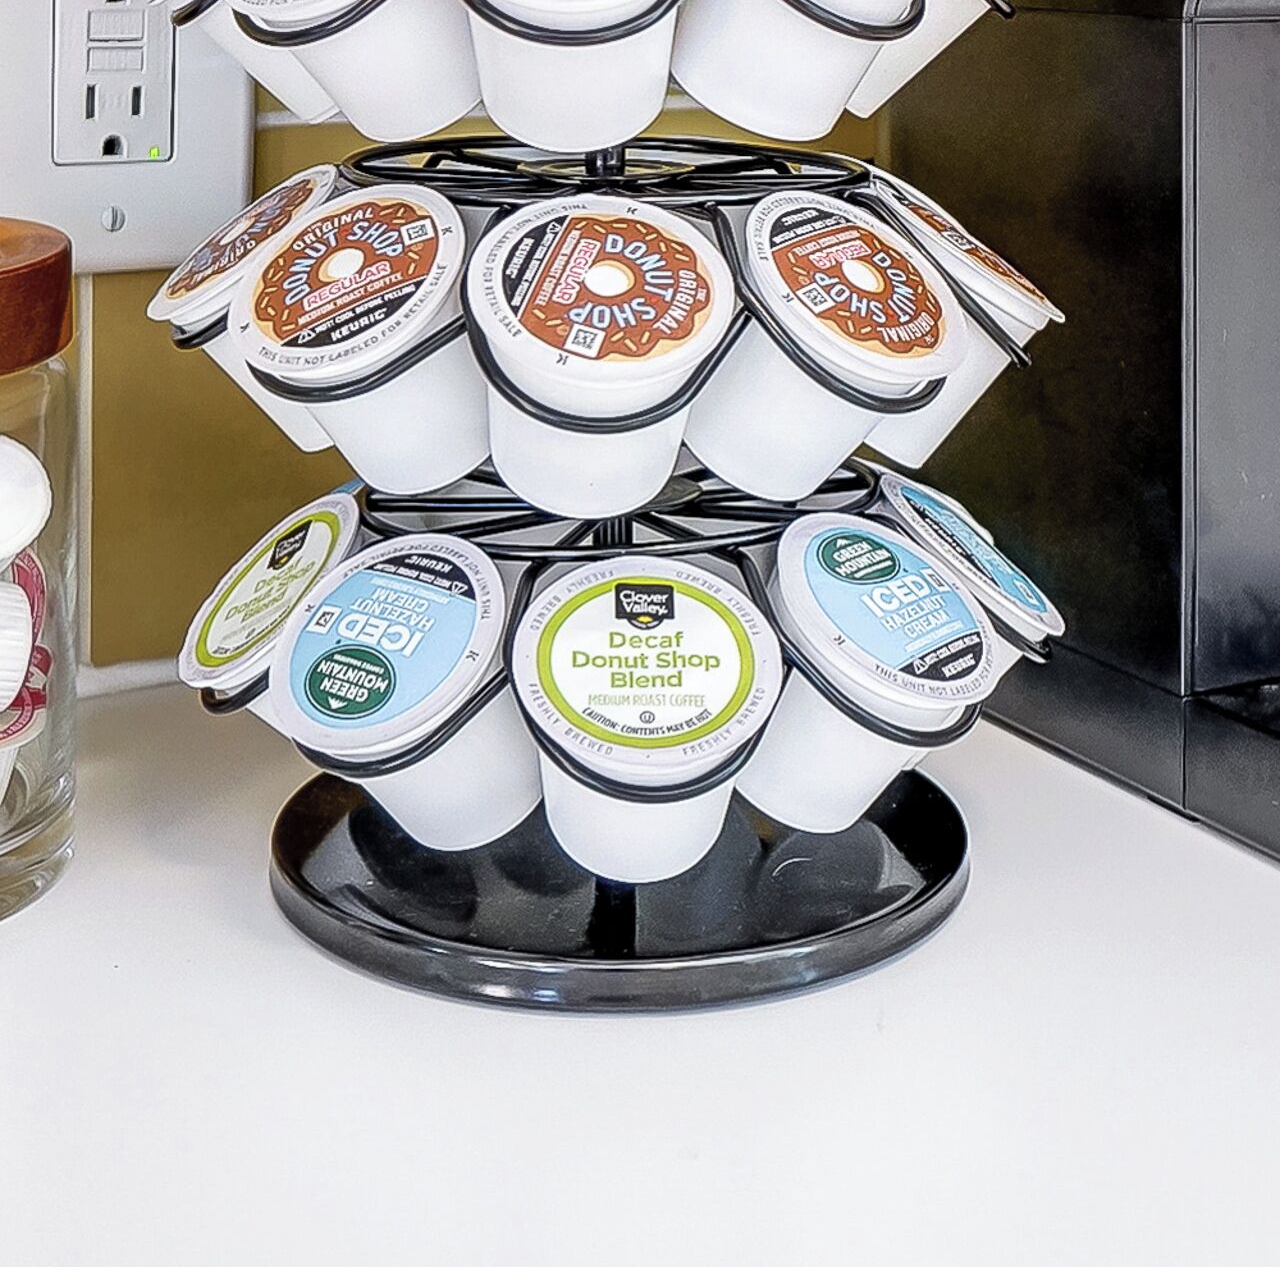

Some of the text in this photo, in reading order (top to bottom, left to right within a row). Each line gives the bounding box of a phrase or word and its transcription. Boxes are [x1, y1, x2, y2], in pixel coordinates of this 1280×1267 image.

[292, 206, 375, 251] ORIGINAL
[282, 221, 406, 305] DONUT SHOP
[553, 239, 601, 304] REGULAR
[303, 261, 391, 310] REGULAR
[569, 234, 676, 329] DONUT SHOP
[812, 252, 916, 324] DONUT SHOP
[653, 268, 699, 335] ORIGINAL
[331, 307, 389, 343] KEURIG
[876, 311, 935, 343] ORIGINAL
[258, 345, 277, 363] THIS
[304, 353, 326, 366] NOT
[405, 555, 453, 574] KEURIG
[833, 541, 872, 563] GREEN
[835, 550, 891, 576] MOUNTAIN
[372, 588, 429, 610] CREAM
[479, 597, 491, 621] THIS
[620, 590, 668, 604] Clover
[861, 574, 931, 617] ICED
[351, 598, 436, 632] HAZELNUT
[880, 595, 945, 631] HAZELNUT
[904, 610, 951, 638] CREAM
[337, 614, 425, 658] ICED
[609, 631, 684, 648] Decaf
[317, 660, 389, 694] MOUNTAIN
[571, 651, 720, 672] Donut Shop
[320, 677, 369, 702] GREEN
[610, 670, 683, 688] Blend
[875, 664, 897, 682] THIS
[900, 677, 926, 692] UNIT
[928, 683, 948, 696] NOT
[588, 694, 706, 707] MEDIUM ROAST COFFEE
[528, 683, 614, 755] FRESHLY BREWED
[582, 707, 620, 732] CAUTION:
[620, 724, 666, 735] CONTENTS
[666, 720, 686, 734] MAY
[682, 727, 734, 756] FRESHLY
